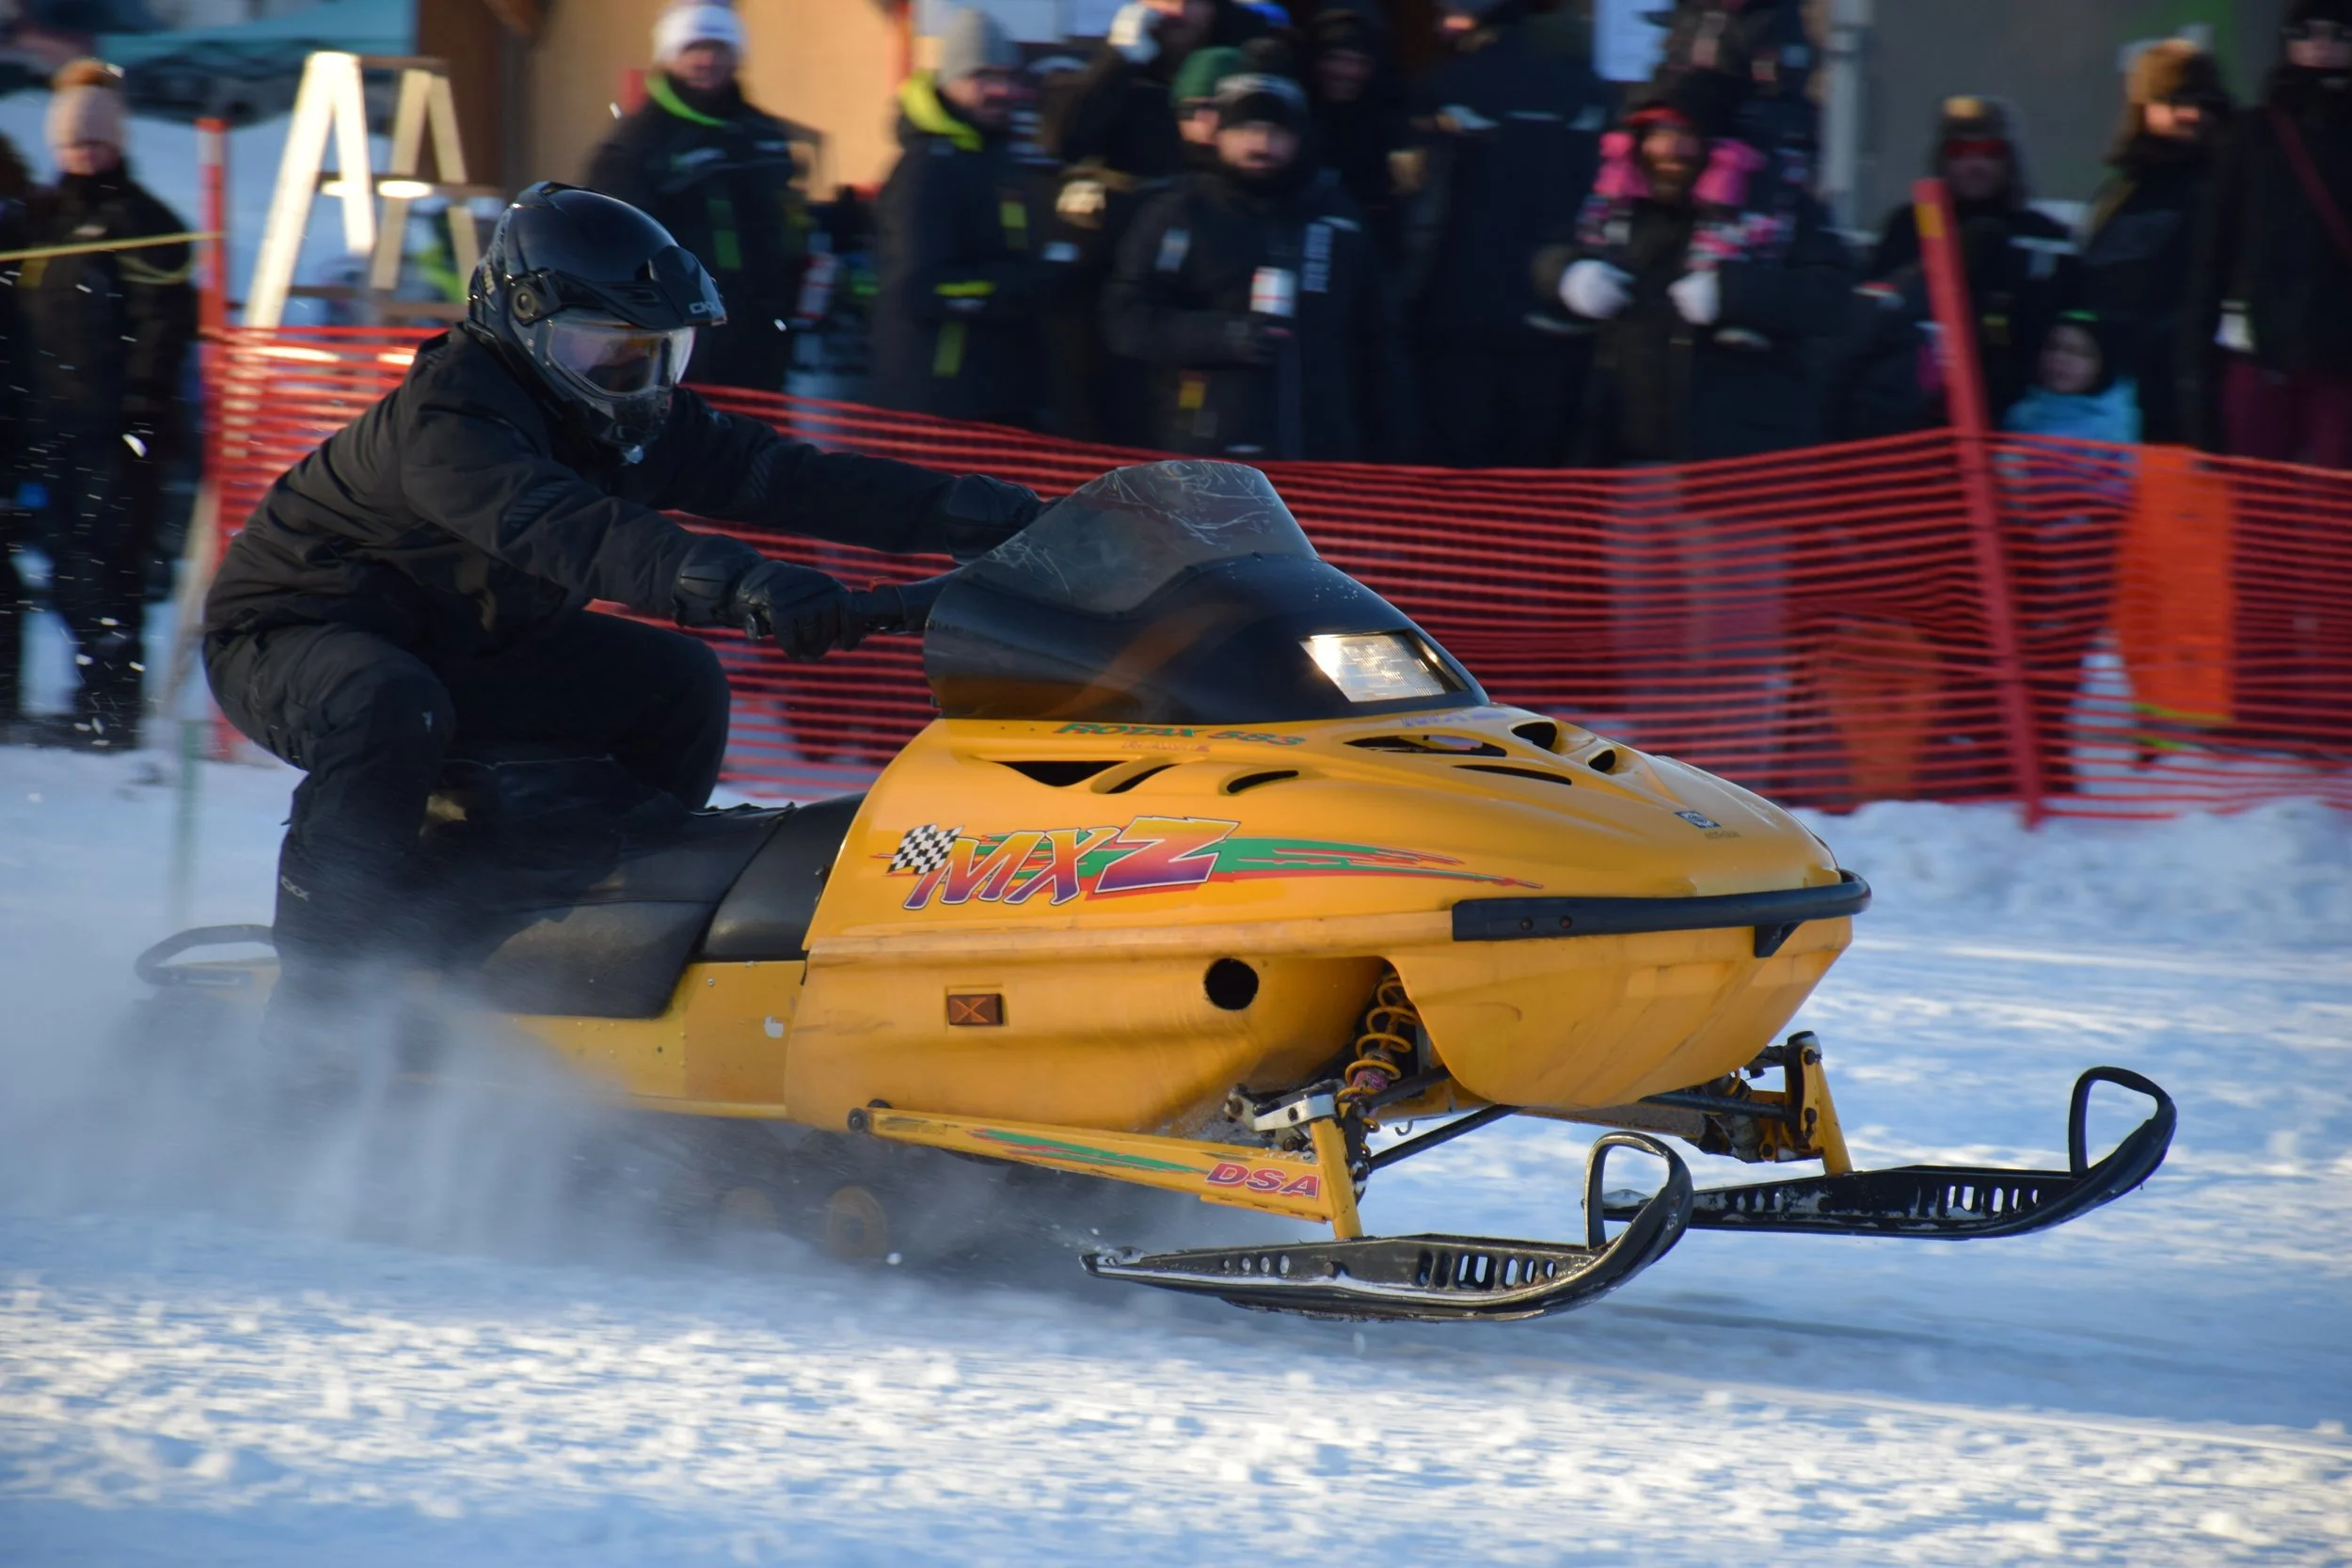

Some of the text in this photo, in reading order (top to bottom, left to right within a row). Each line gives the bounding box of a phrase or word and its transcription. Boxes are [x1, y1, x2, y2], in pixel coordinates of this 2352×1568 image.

[1052, 721, 1306, 746] ROTAX 583
[903, 816, 1241, 909] MXZ
[1204, 1161, 1320, 1199] DSA
